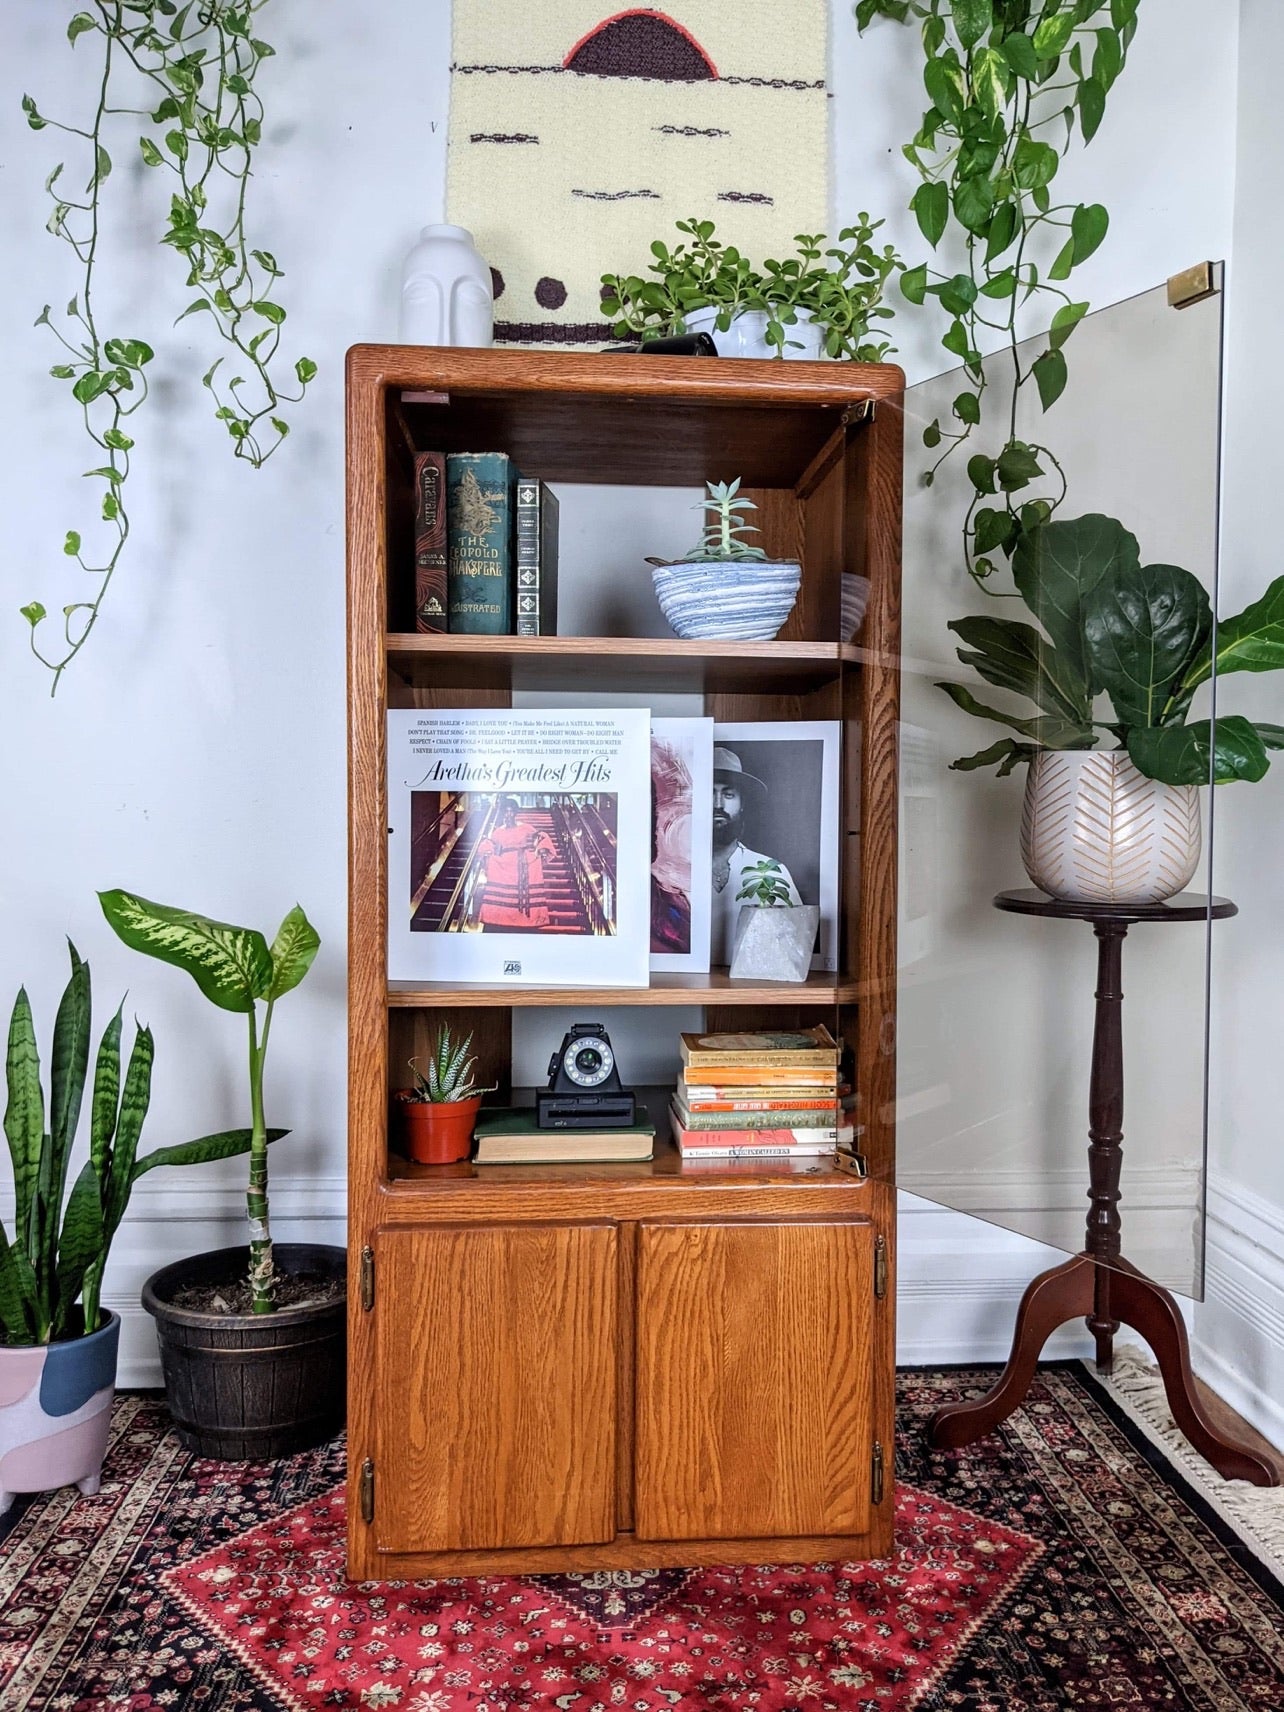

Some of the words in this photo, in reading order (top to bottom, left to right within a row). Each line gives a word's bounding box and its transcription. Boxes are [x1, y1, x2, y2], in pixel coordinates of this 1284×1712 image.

[422, 466, 439, 525] Caravans
[458, 535, 489, 548] THE
[404, 759, 494, 788] Aretha's
[493, 759, 567, 789] Greatest
[559, 754, 612, 789] Hits
